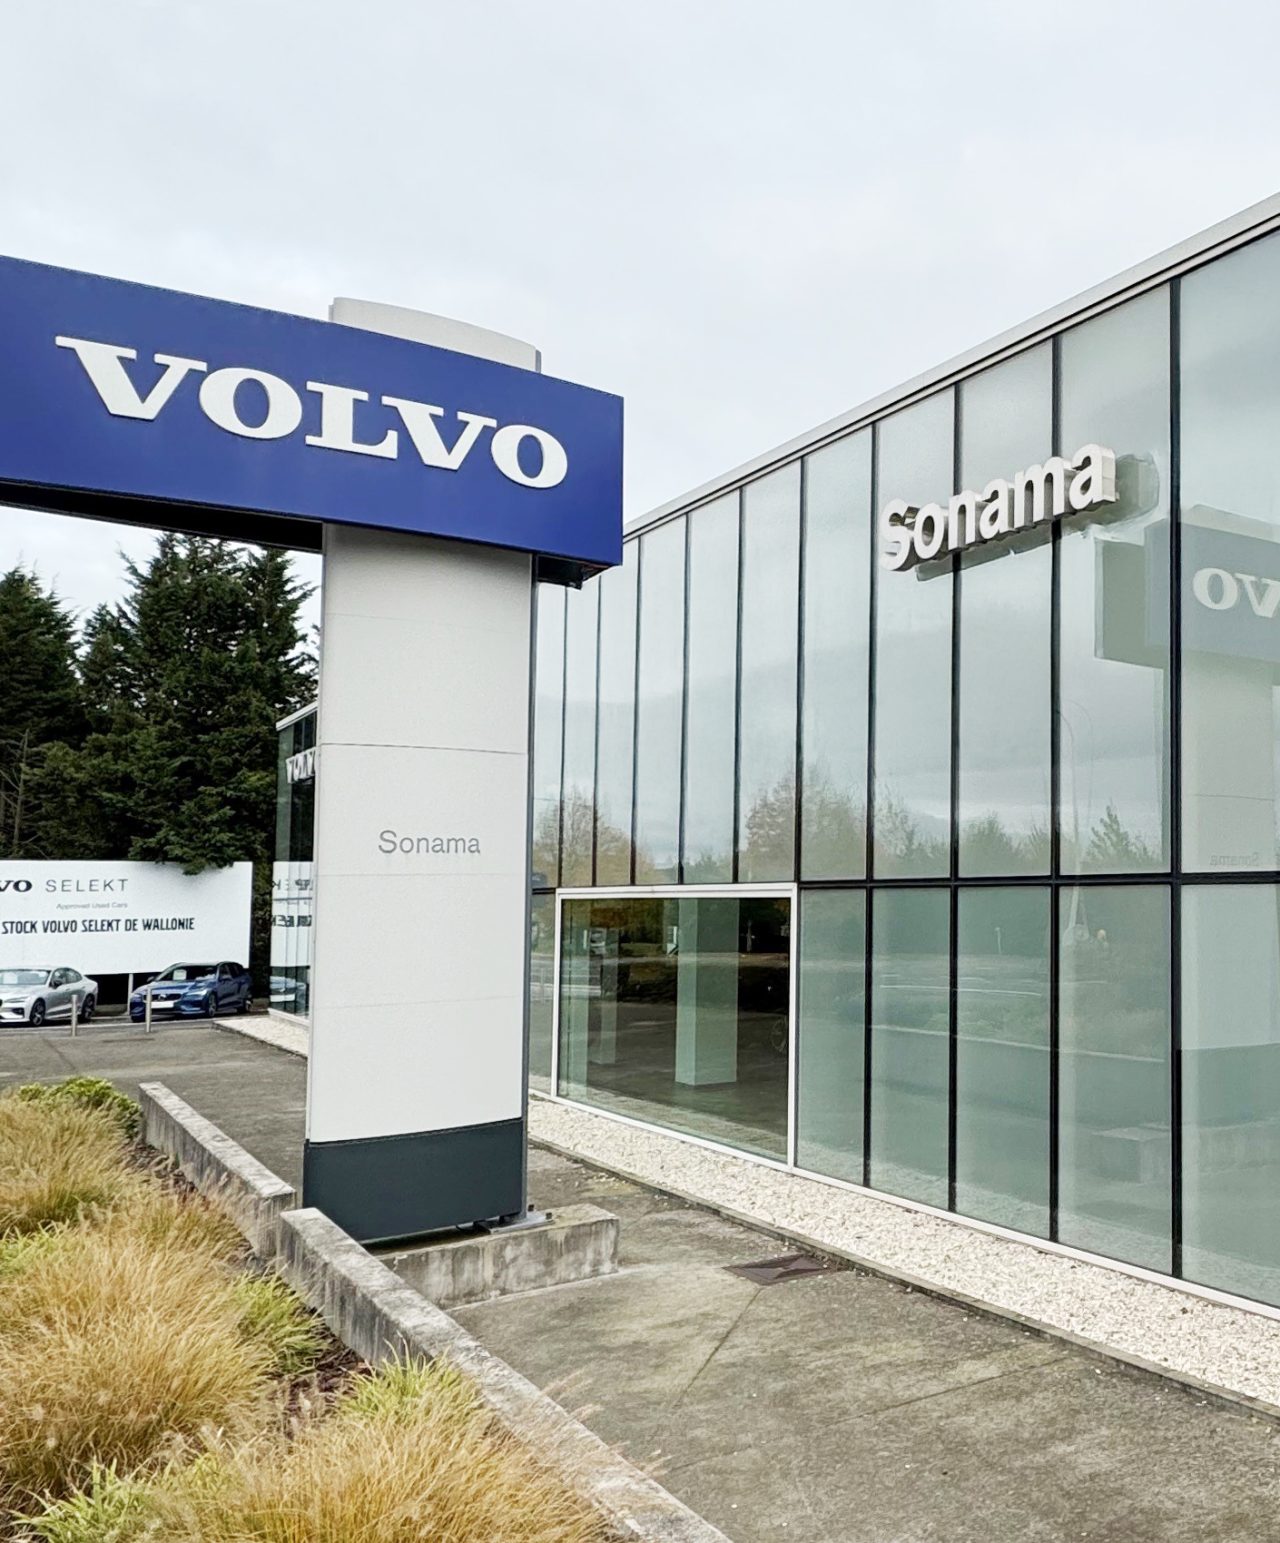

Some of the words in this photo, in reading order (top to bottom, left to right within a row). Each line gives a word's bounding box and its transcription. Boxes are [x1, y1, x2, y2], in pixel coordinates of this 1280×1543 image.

[55, 336, 568, 489] VOLVO
[879, 443, 1116, 572] Sonama
[378, 830, 481, 854] Sonama
[45, 879, 128, 892] SELEKT
[2, 920, 38, 934] STOCK
[42, 920, 77, 933] VOLVO
[81, 919, 121, 932] SELEKT
[124, 919, 138, 931] DE
[142, 917, 195, 931] WALLONIE
